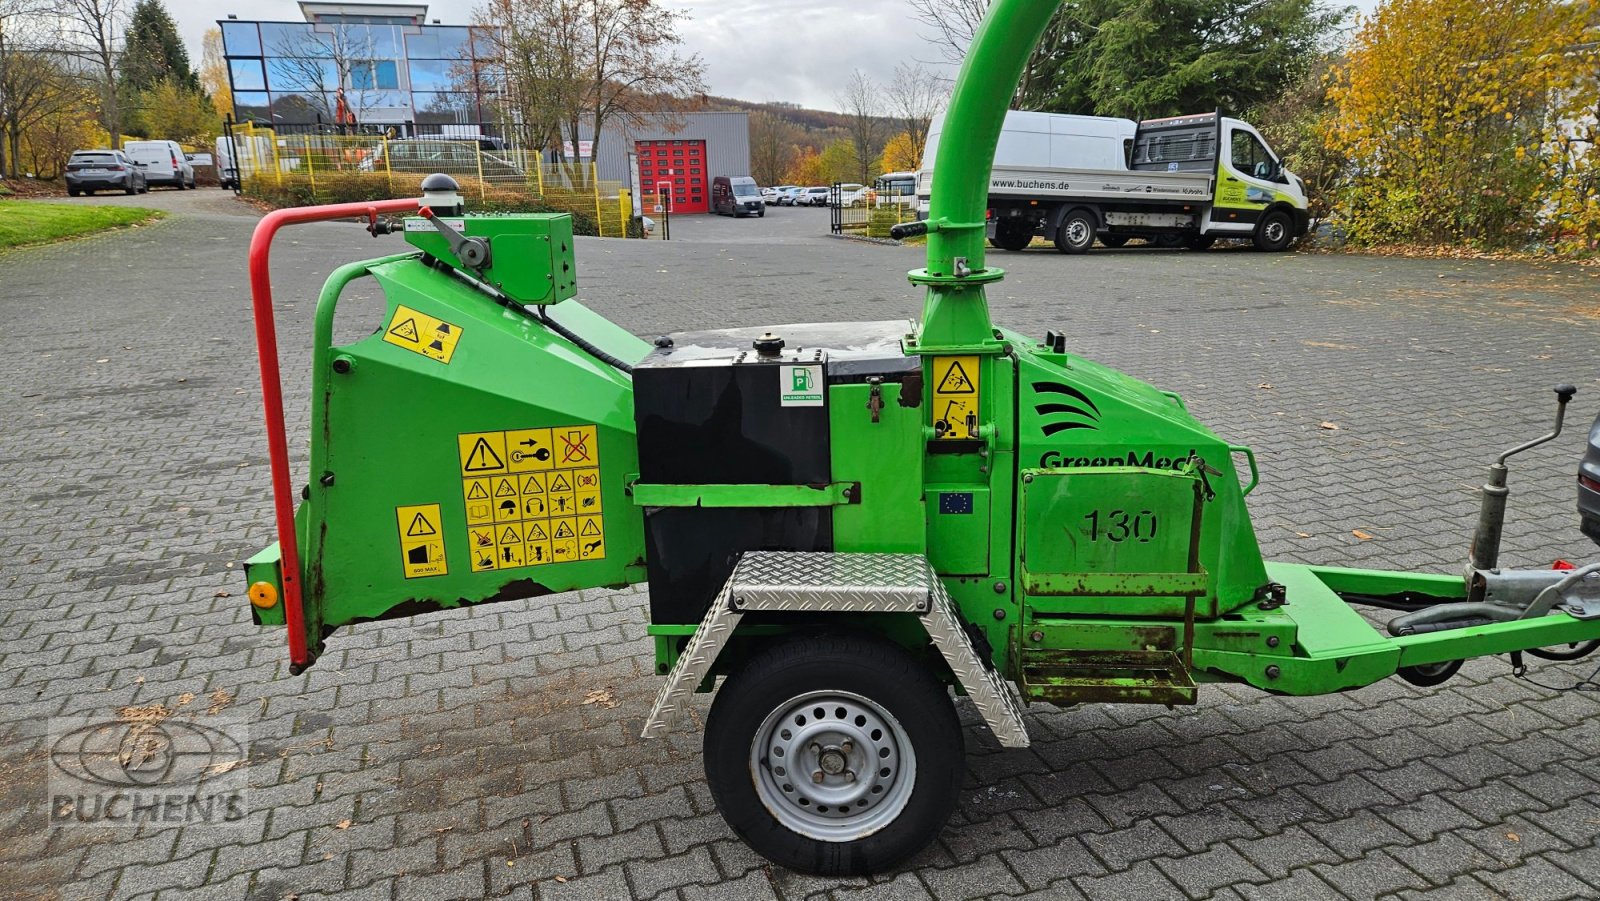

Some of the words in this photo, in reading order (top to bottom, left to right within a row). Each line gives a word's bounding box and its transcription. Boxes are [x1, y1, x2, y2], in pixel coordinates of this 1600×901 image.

[992, 180, 1070, 190] www.buchens.de
[797, 378, 804, 387] P
[1084, 510, 1157, 542] 130
